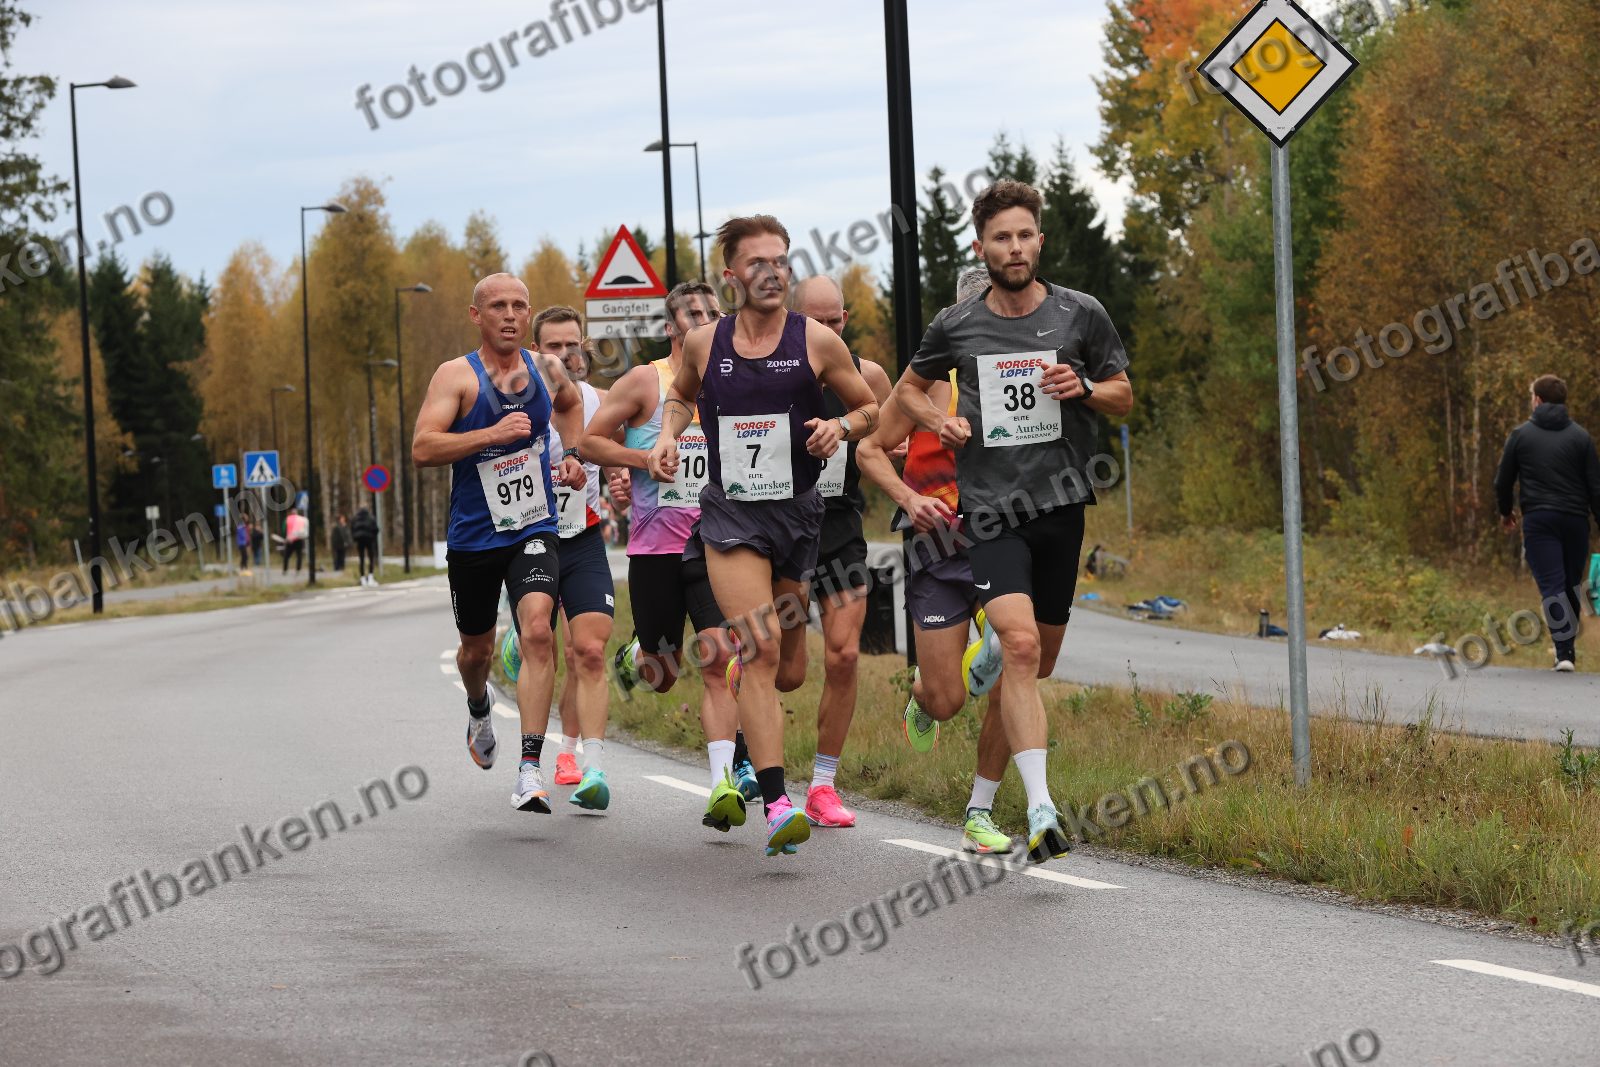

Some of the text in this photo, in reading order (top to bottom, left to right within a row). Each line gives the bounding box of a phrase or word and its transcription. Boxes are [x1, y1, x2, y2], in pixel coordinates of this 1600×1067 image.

[602, 304, 649, 316] Gangfelt
[606, 325, 613, 334] 0
[767, 358, 800, 368] zooca
[995, 358, 1043, 370] NORGES
[1000, 367, 1035, 379] LØPET
[1003, 382, 1036, 412] 38
[734, 420, 776, 430] NORGES
[1015, 422, 1059, 434] Aurskog
[737, 429, 770, 439] LØPET
[1015, 432, 1052, 440] SPAREBANK
[493, 453, 529, 472] NORGES
[746, 444, 762, 469] 7
[499, 462, 525, 477] LØPET
[682, 455, 706, 479] 10
[497, 474, 534, 506] 979
[750, 480, 791, 491] Aurskog
[519, 503, 547, 519] Aurskog
[923, 615, 946, 623] HOKA
